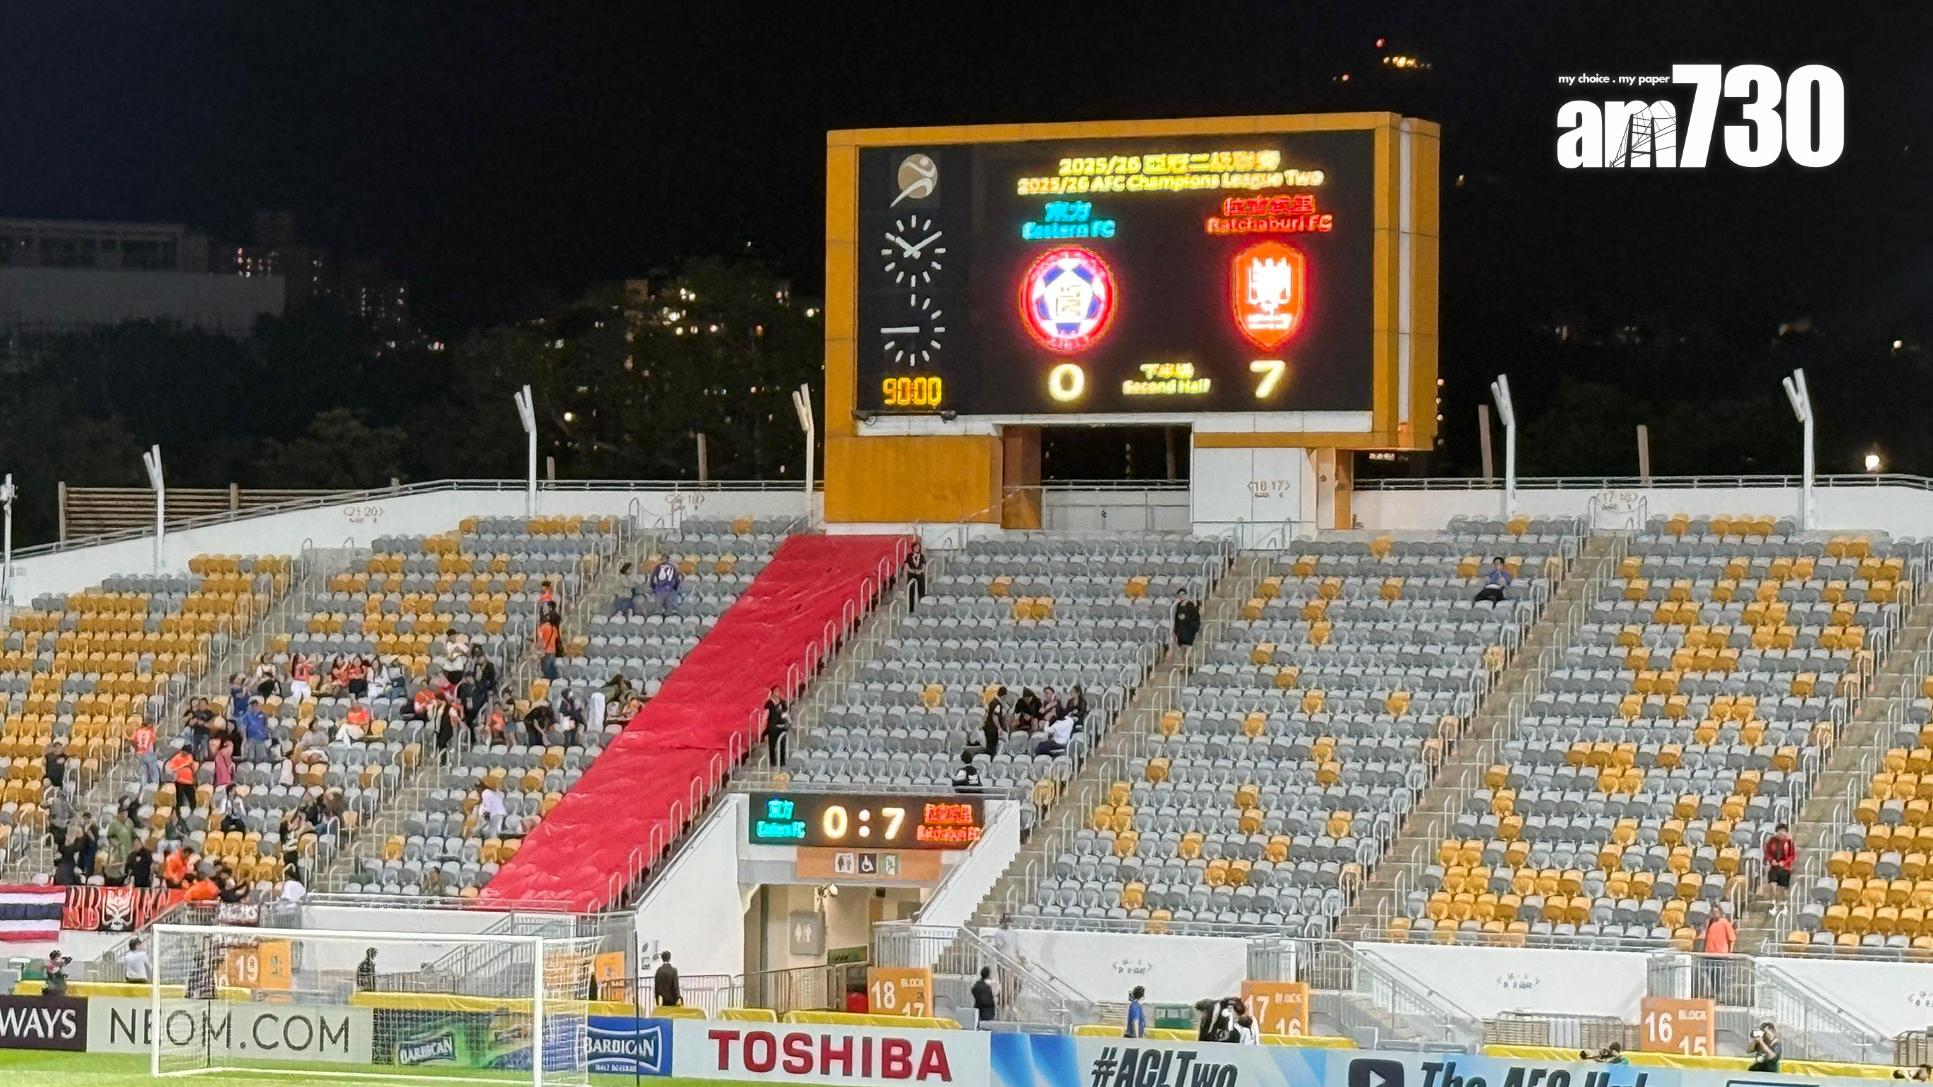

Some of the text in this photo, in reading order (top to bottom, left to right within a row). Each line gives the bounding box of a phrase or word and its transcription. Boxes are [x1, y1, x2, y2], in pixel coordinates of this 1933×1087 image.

[1090, 174, 1126, 193] AFC
[1126, 171, 1220, 192] Champions
[1220, 171, 1283, 190] League
[1090, 219, 1116, 238] FC
[1206, 214, 1333, 235] Ratchaburi FC
[1048, 363, 1086, 402] 0
[1249, 360, 1286, 399] 7
[822, 805, 848, 839] 0
[881, 807, 905, 840] 7
[234, 954, 259, 983] 19
[871, 980, 896, 1009] 18
[110, 1008, 350, 1053] NEOM.COM
[1645, 1009, 1707, 1042] 16 BLOCK
[583, 1036, 655, 1058] BARBICAN
[708, 1029, 952, 1082] TOSHIBA
